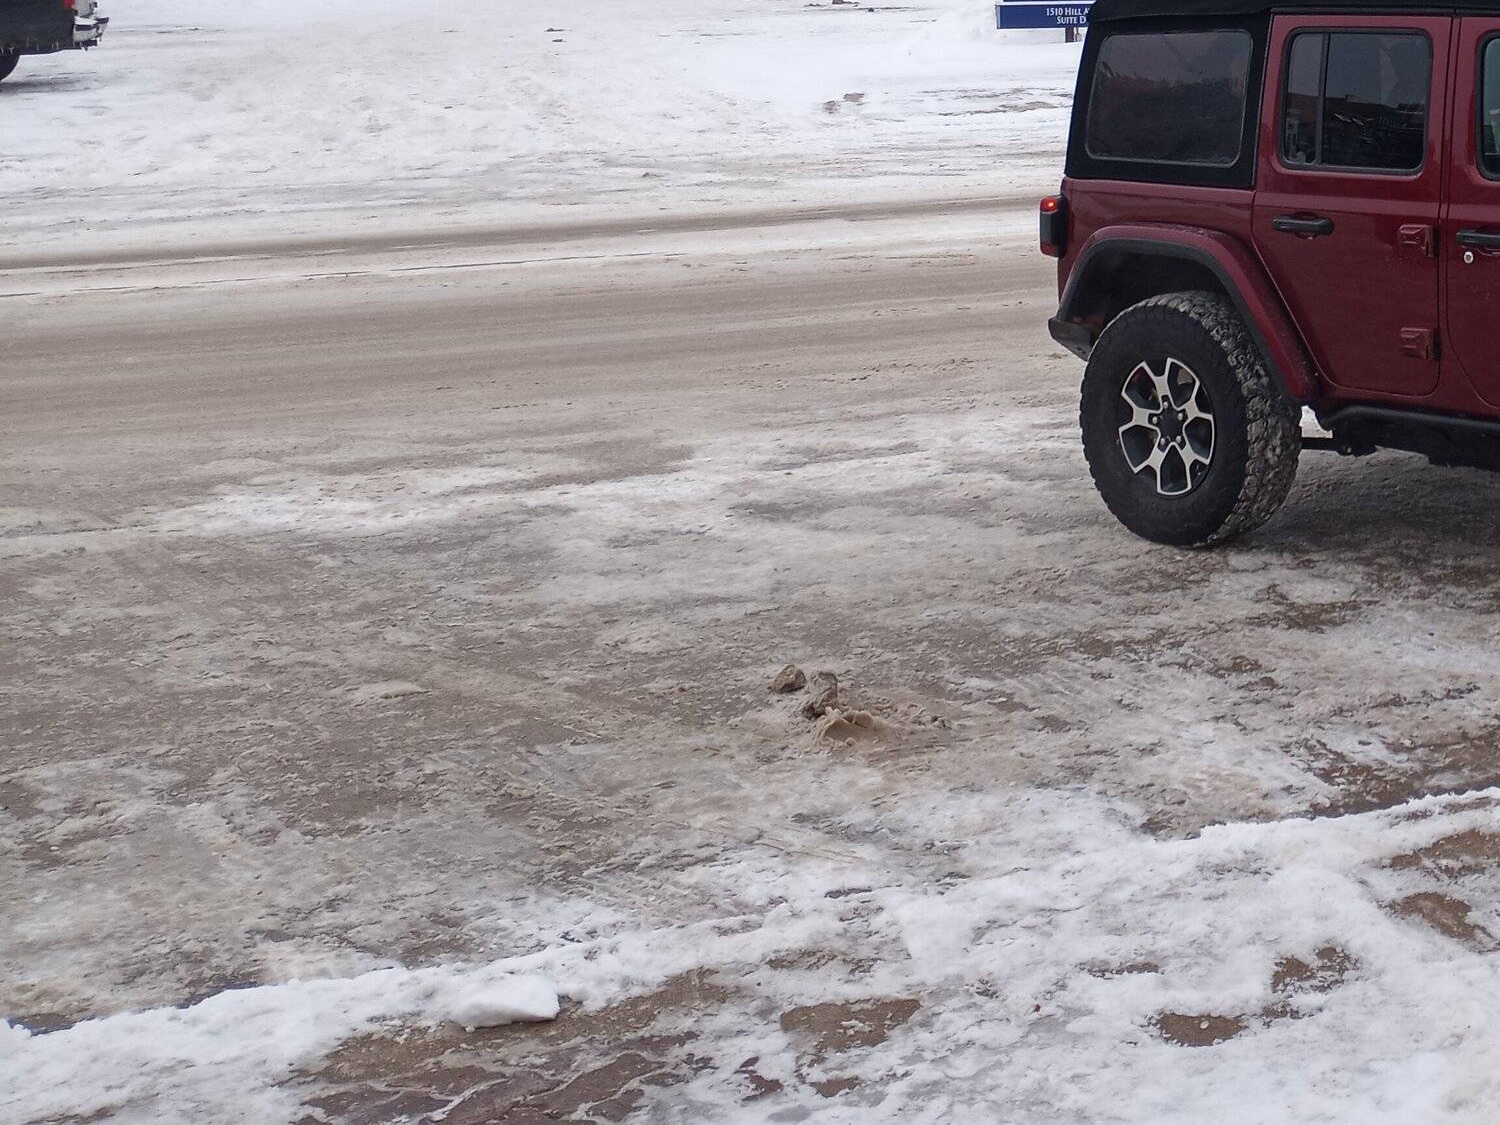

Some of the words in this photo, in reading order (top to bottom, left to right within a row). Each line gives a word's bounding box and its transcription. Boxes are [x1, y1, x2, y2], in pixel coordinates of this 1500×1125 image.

[1046, 7, 1063, 16] 1510
[1064, 7, 1082, 16] HILL
[1056, 15, 1078, 24] SUITE
